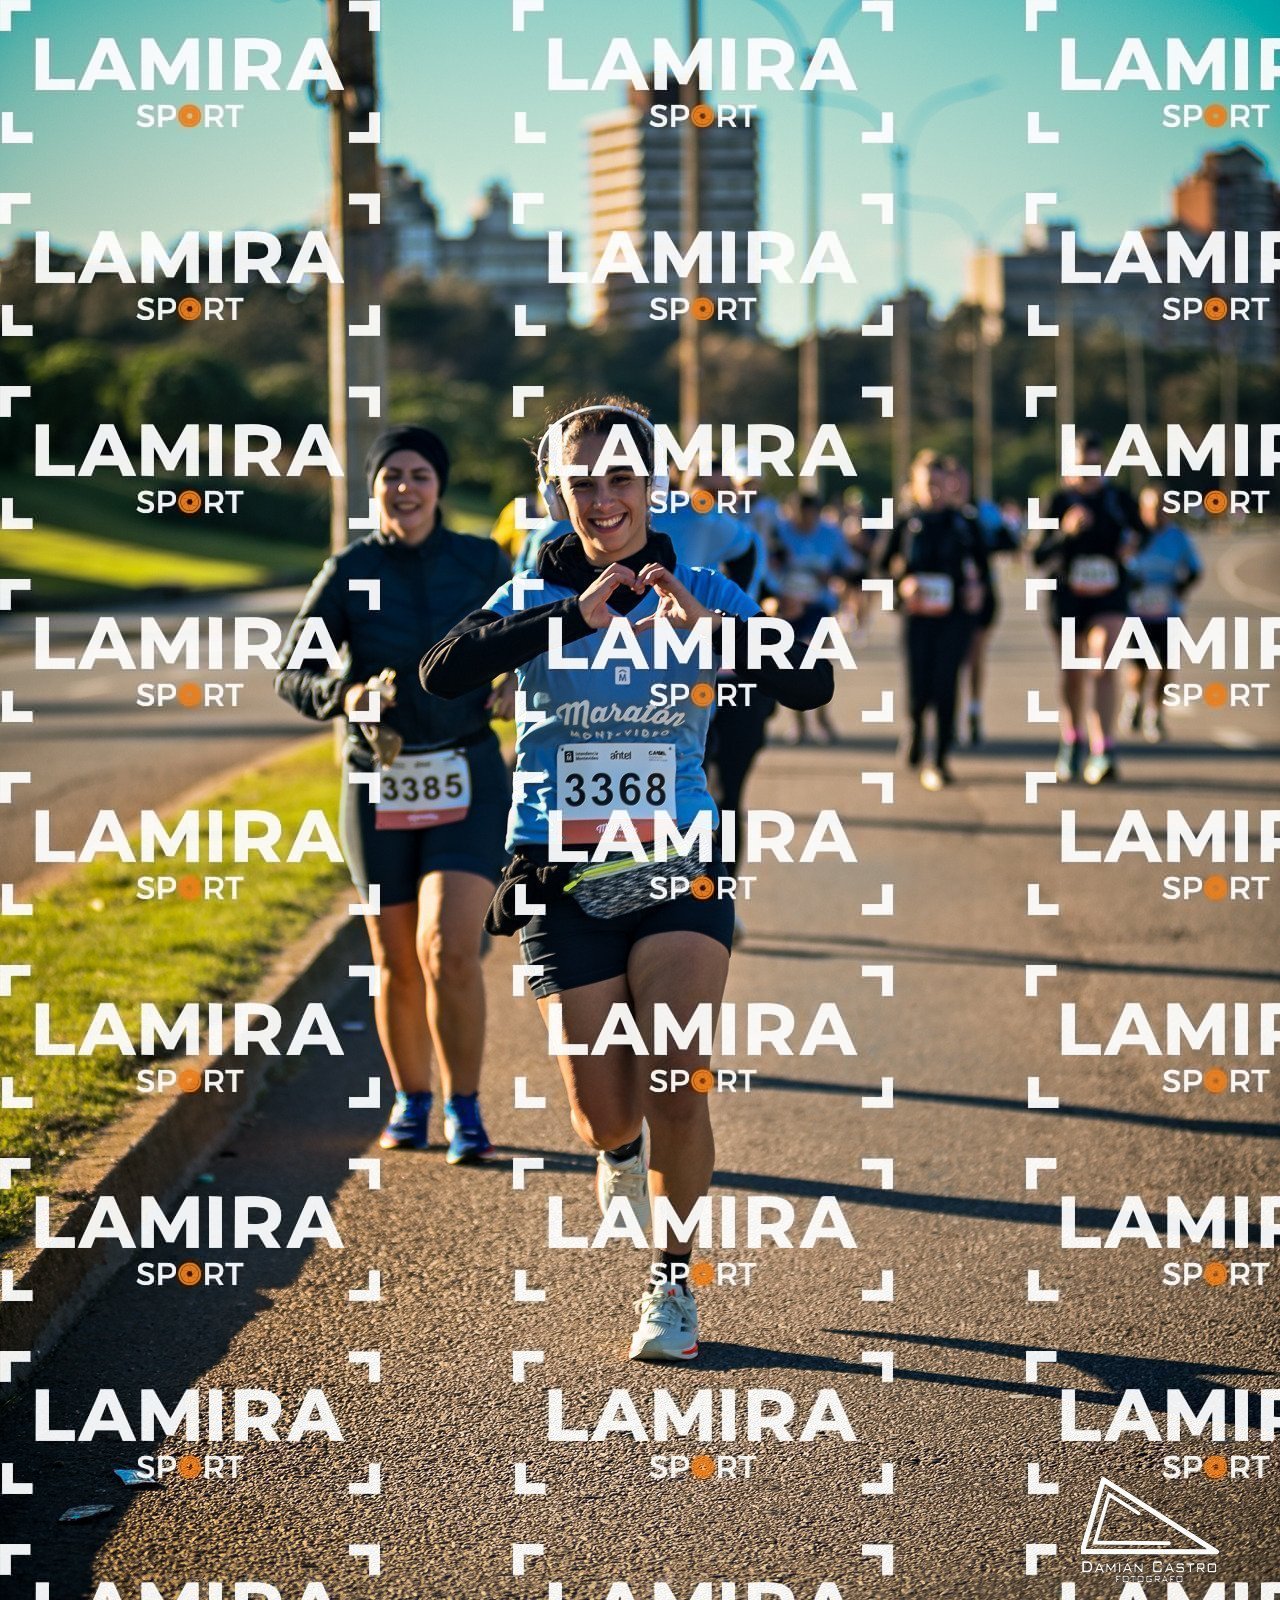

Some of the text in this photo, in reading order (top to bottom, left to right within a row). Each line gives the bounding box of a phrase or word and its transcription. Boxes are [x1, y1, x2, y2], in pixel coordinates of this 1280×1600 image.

[556, 699, 686, 729] Maratón
[381, 773, 463, 802] 3385
[564, 772, 667, 807] 3368
